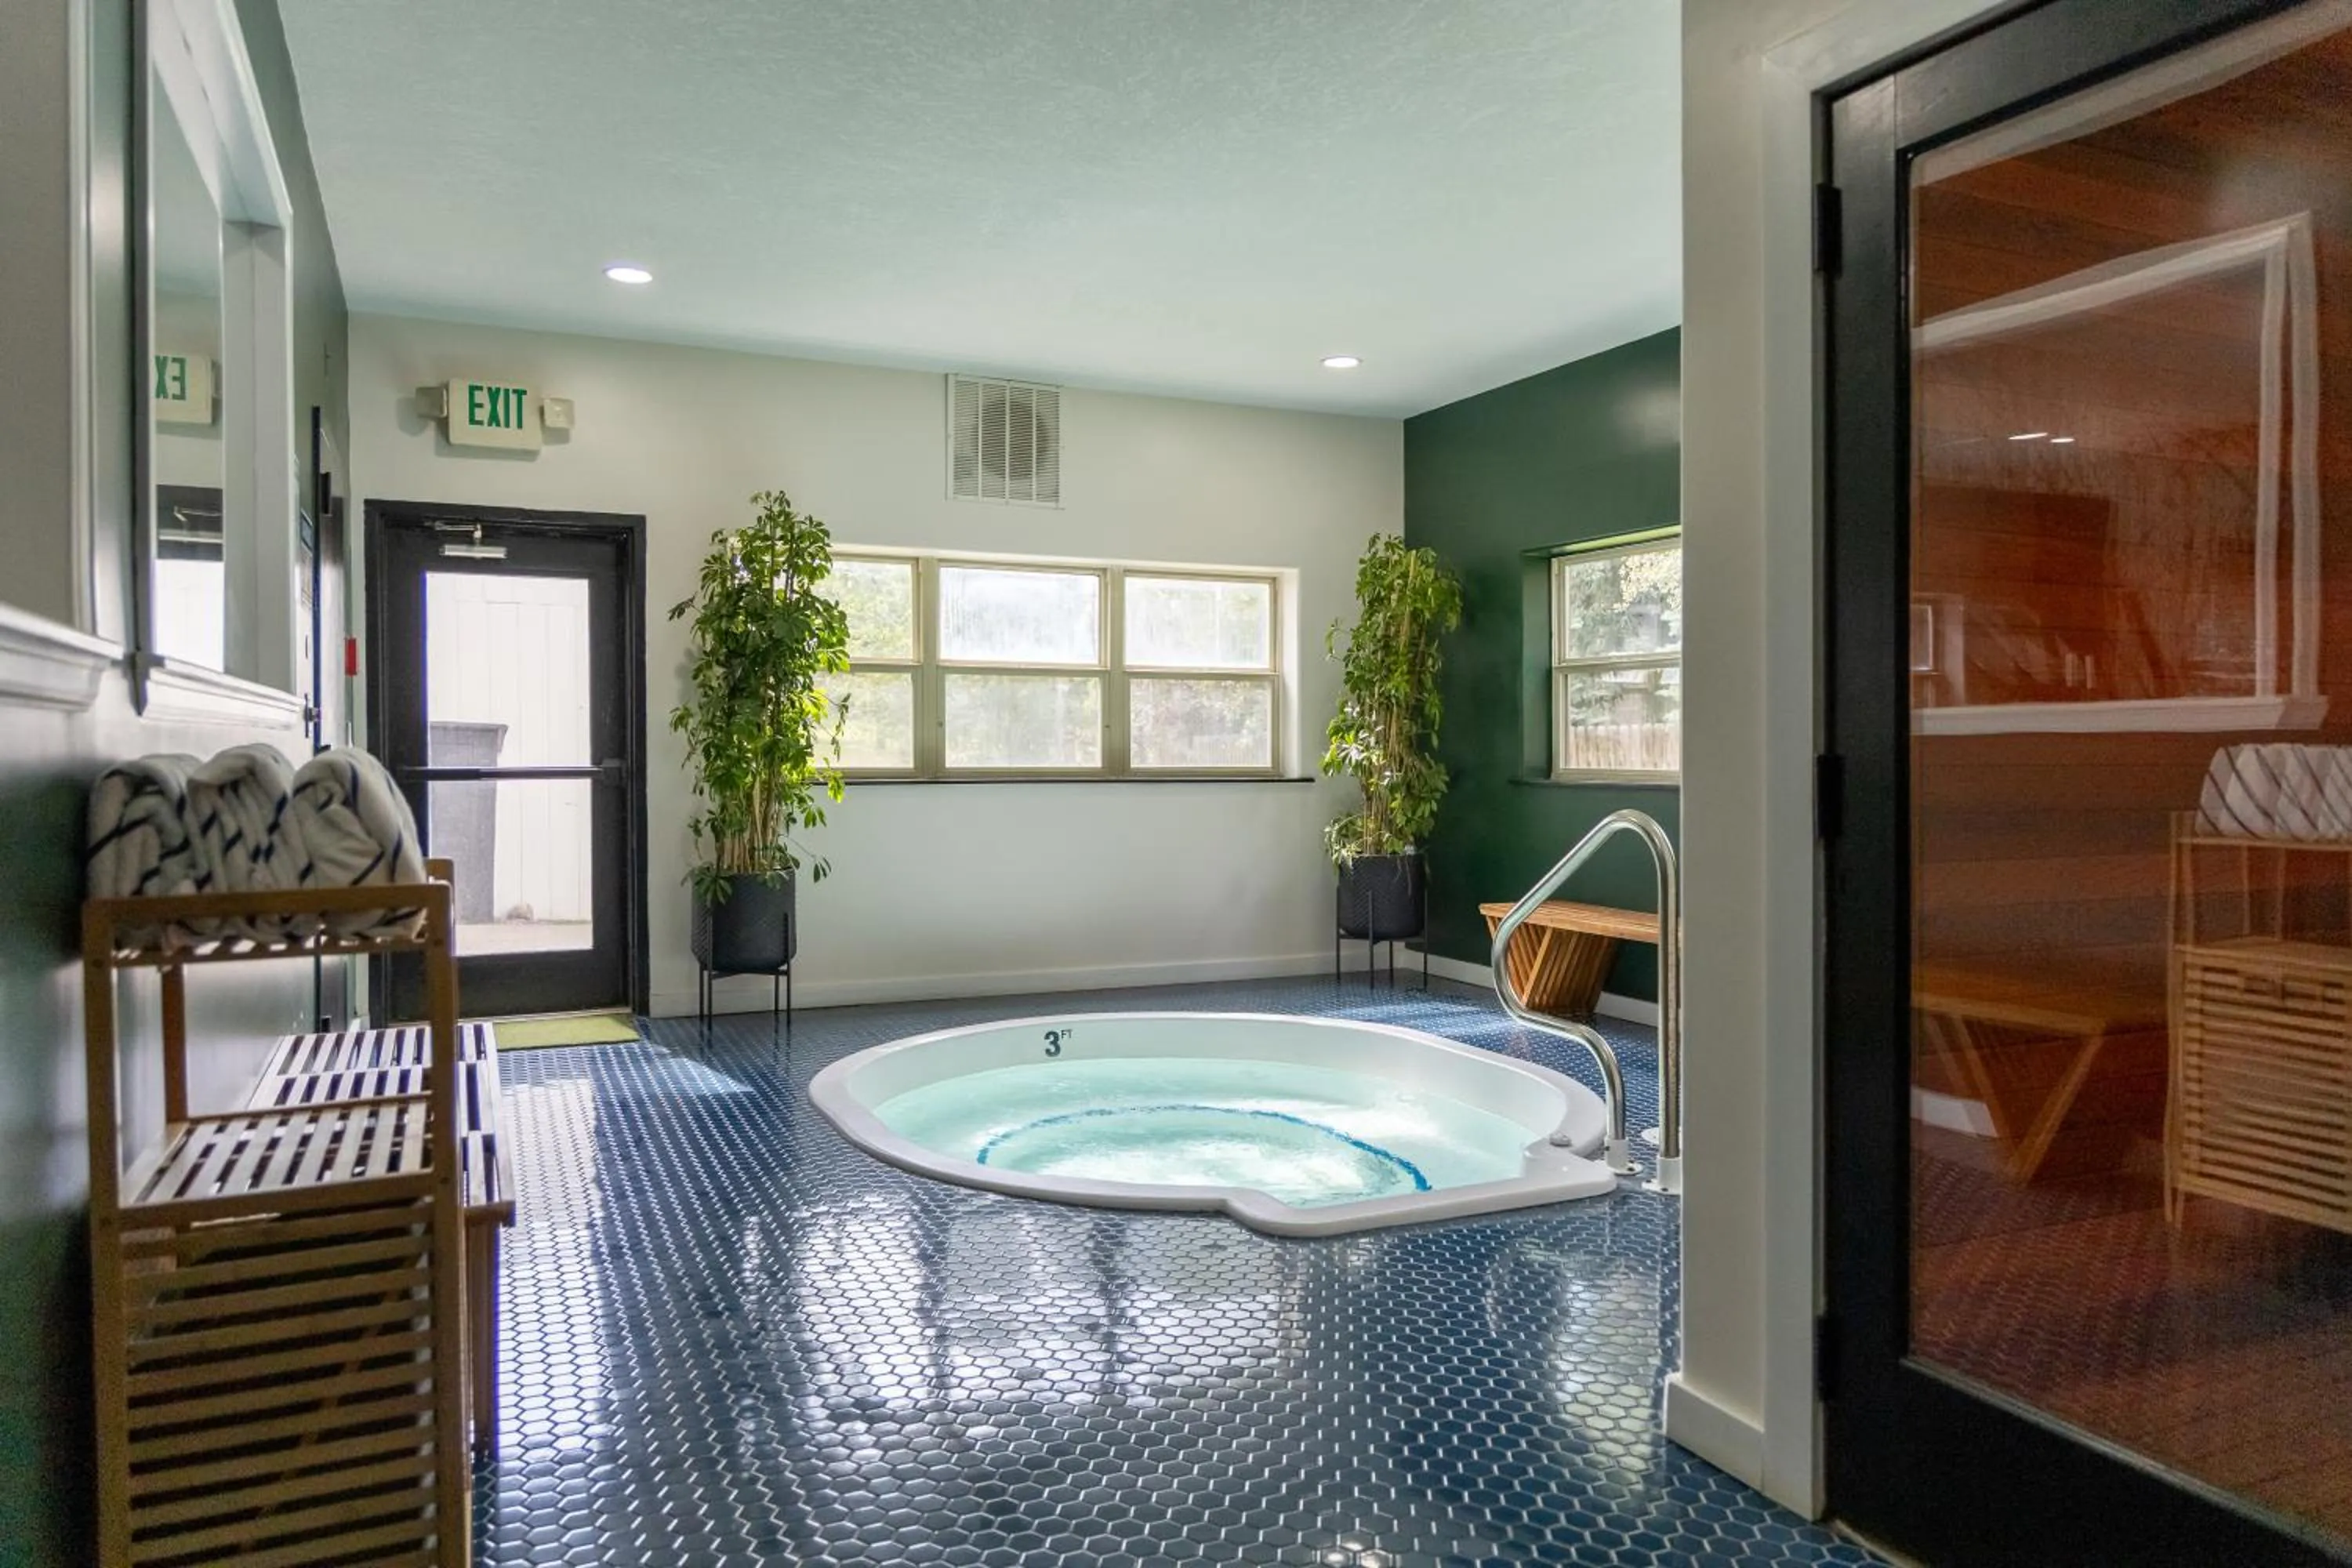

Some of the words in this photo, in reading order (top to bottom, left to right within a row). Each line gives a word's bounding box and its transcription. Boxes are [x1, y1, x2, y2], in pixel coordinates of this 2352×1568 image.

[468, 384, 527, 430] EXIT
[1044, 1031, 1060, 1057] 3
[1061, 1029, 1073, 1038] FT
